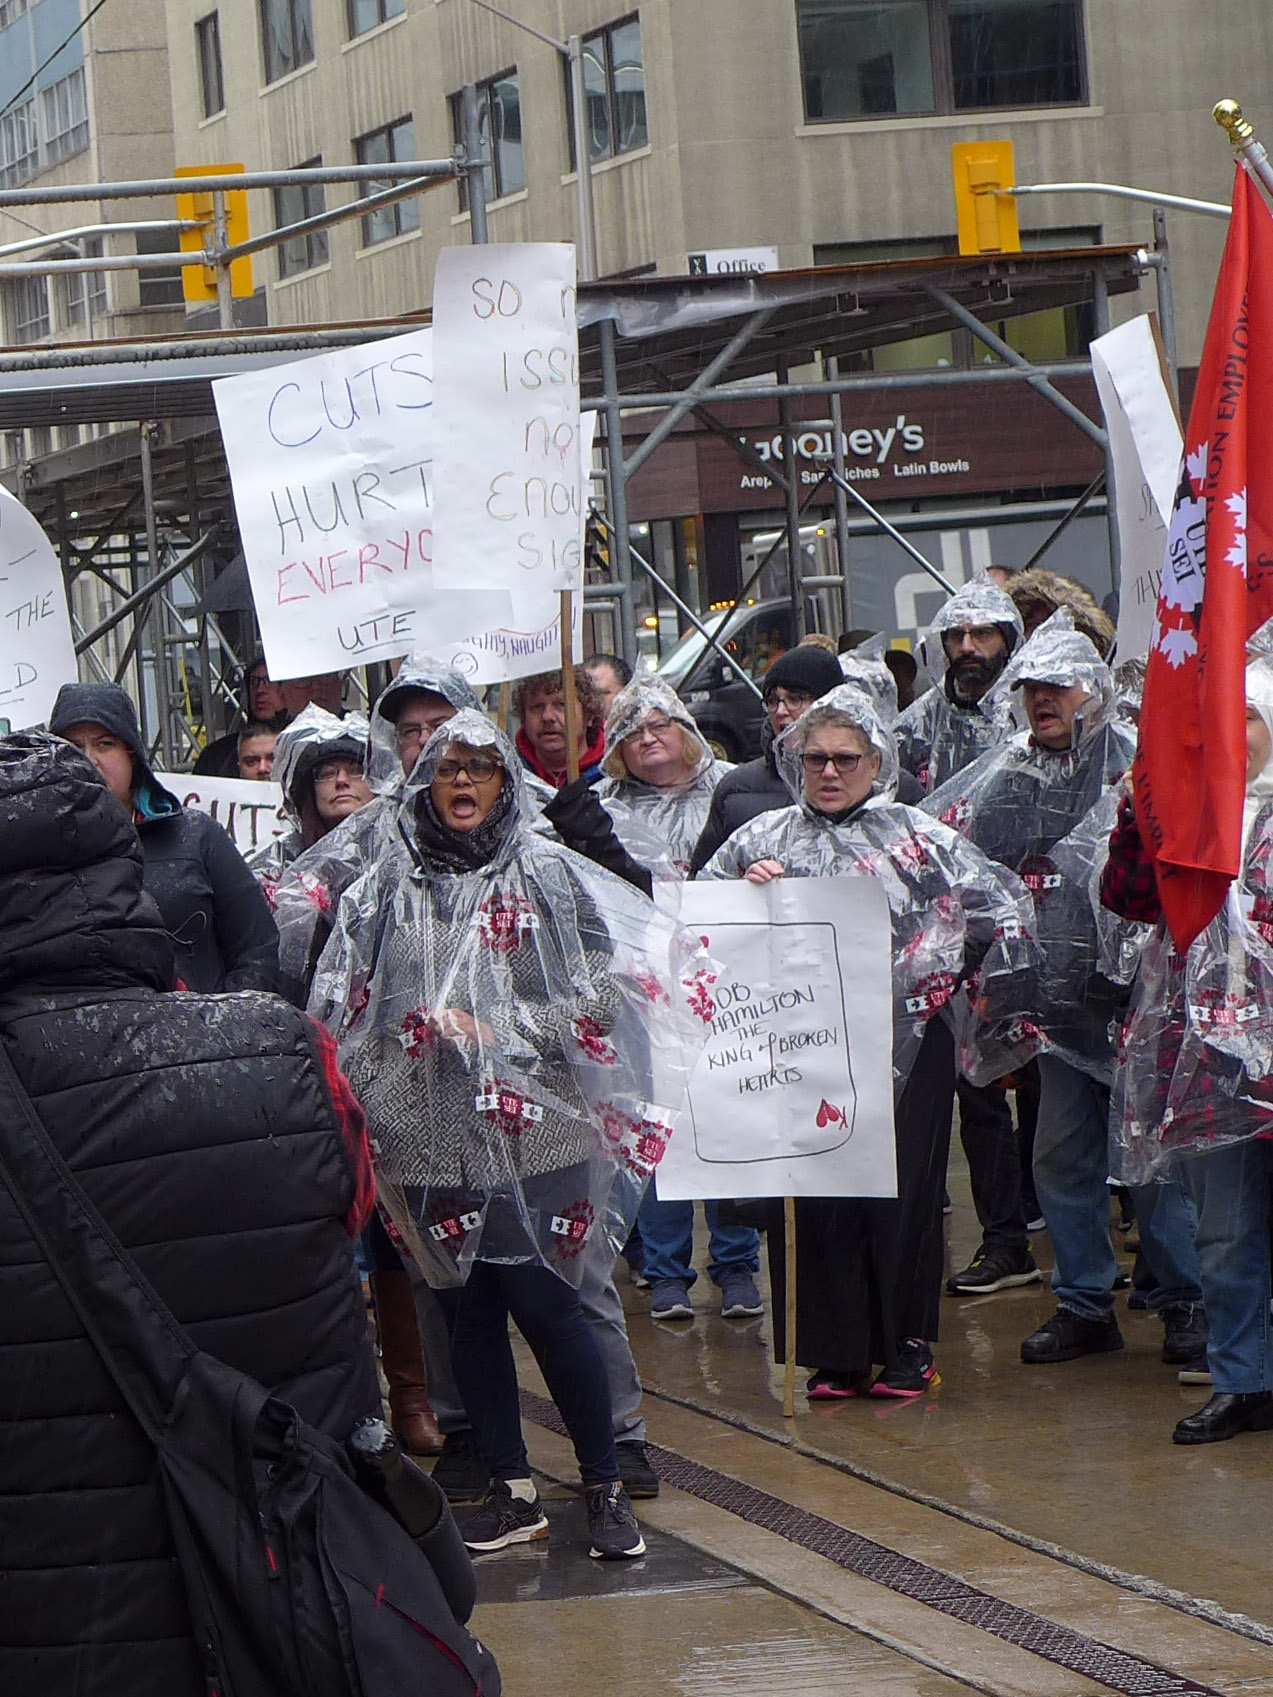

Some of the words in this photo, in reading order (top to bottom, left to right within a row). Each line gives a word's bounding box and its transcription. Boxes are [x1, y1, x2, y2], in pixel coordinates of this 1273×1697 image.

[717, 258, 767, 274] Office
[472, 277, 522, 319] SO
[268, 353, 433, 447] CUTS
[740, 474, 773, 489] Arep
[801, 467, 880, 485] Saiches
[894, 463, 927, 477] Latin
[929, 459, 970, 474] Bowls
[271, 460, 433, 556] HURT
[1169, 538, 1196, 584] SEI
[5, 590, 56, 631] THE
[338, 610, 417, 652] UTE
[711, 984, 815, 1036] HAMILTON
[729, 1020, 770, 1041] THE
[708, 1043, 753, 1070] KING
[779, 1027, 837, 1054] BROKEN
[739, 1067, 803, 1094] HEARTS
